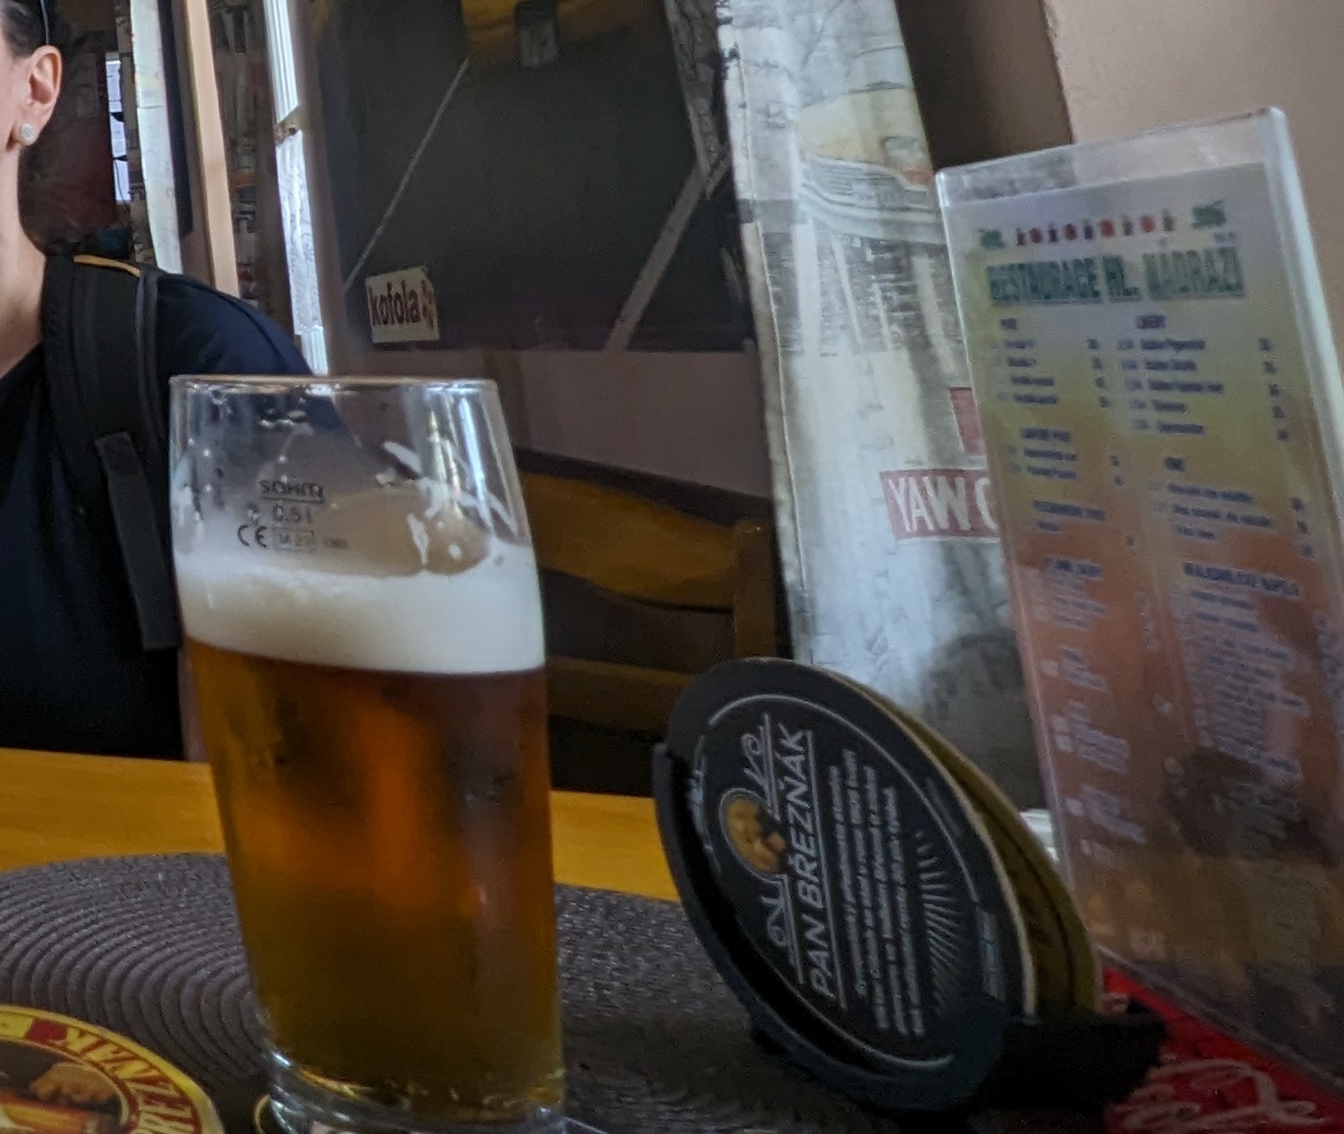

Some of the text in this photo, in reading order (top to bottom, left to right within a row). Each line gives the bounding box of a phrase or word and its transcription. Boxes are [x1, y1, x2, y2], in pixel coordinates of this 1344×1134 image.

[369, 279, 421, 327] kofola
[774, 723, 836, 998] PAN BŘEZŇÁK
